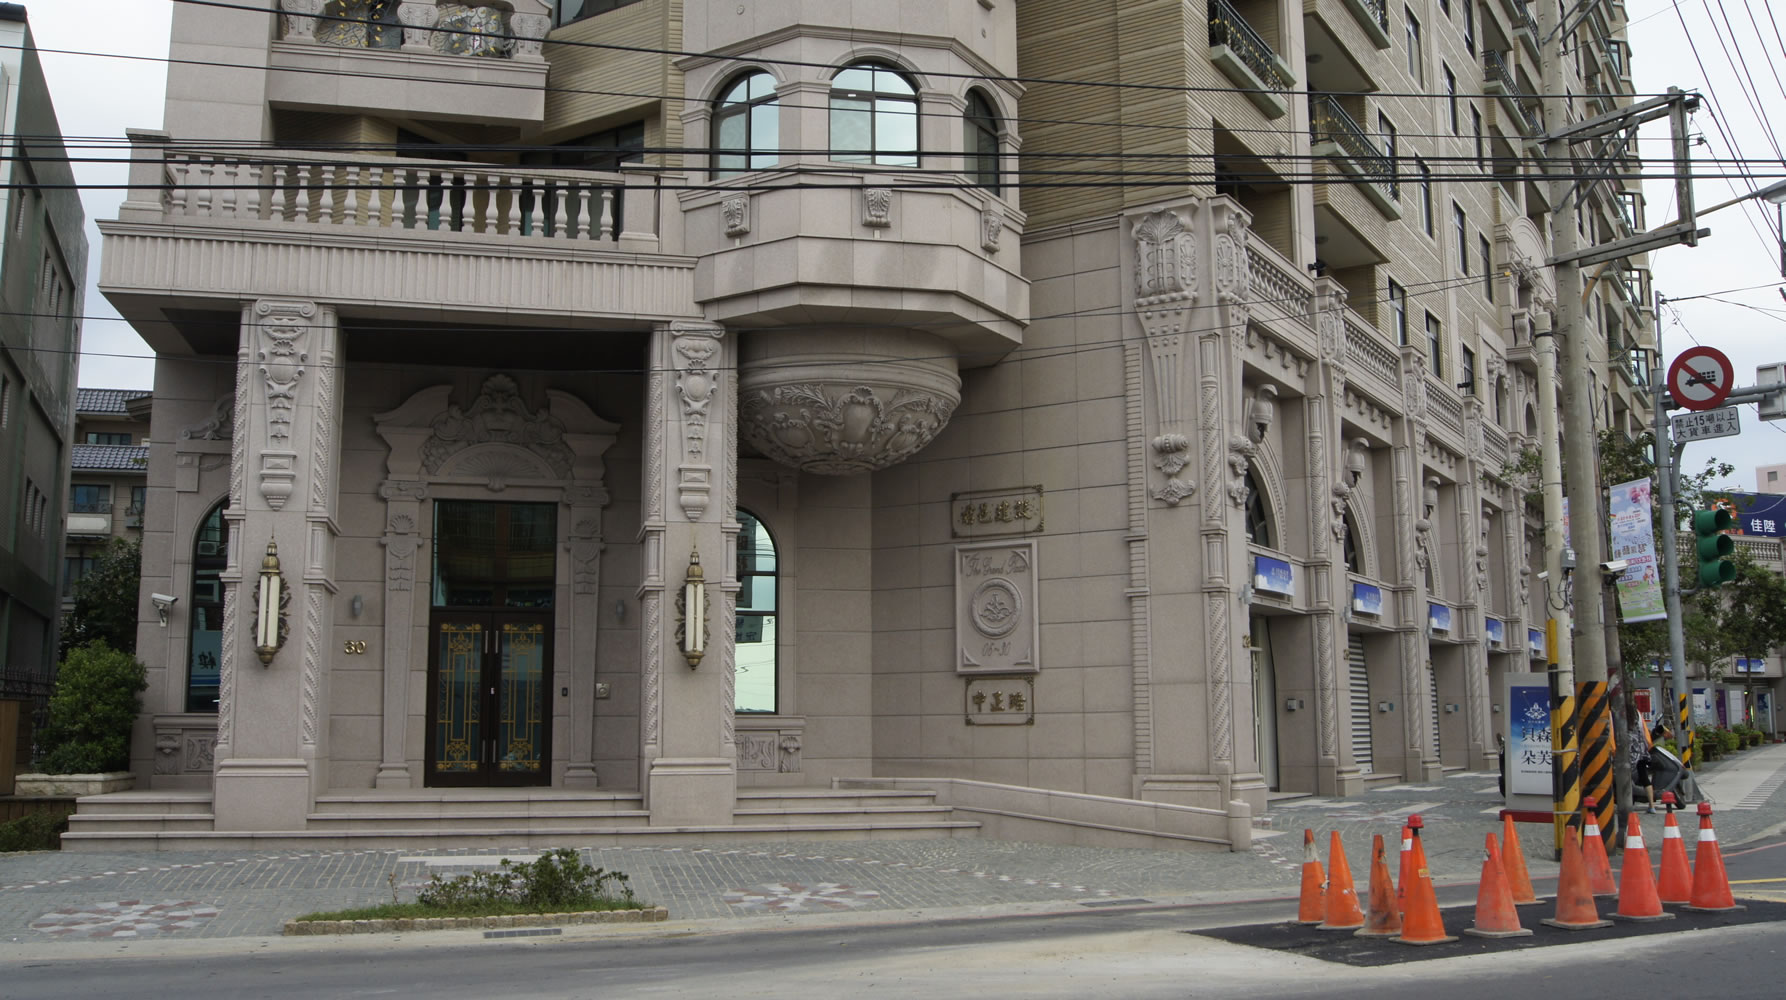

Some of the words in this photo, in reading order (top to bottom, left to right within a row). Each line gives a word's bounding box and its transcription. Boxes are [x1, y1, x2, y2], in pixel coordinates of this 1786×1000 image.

[1676, 421, 1737, 440] 大貨車進入
[344, 640, 366, 655] 30
